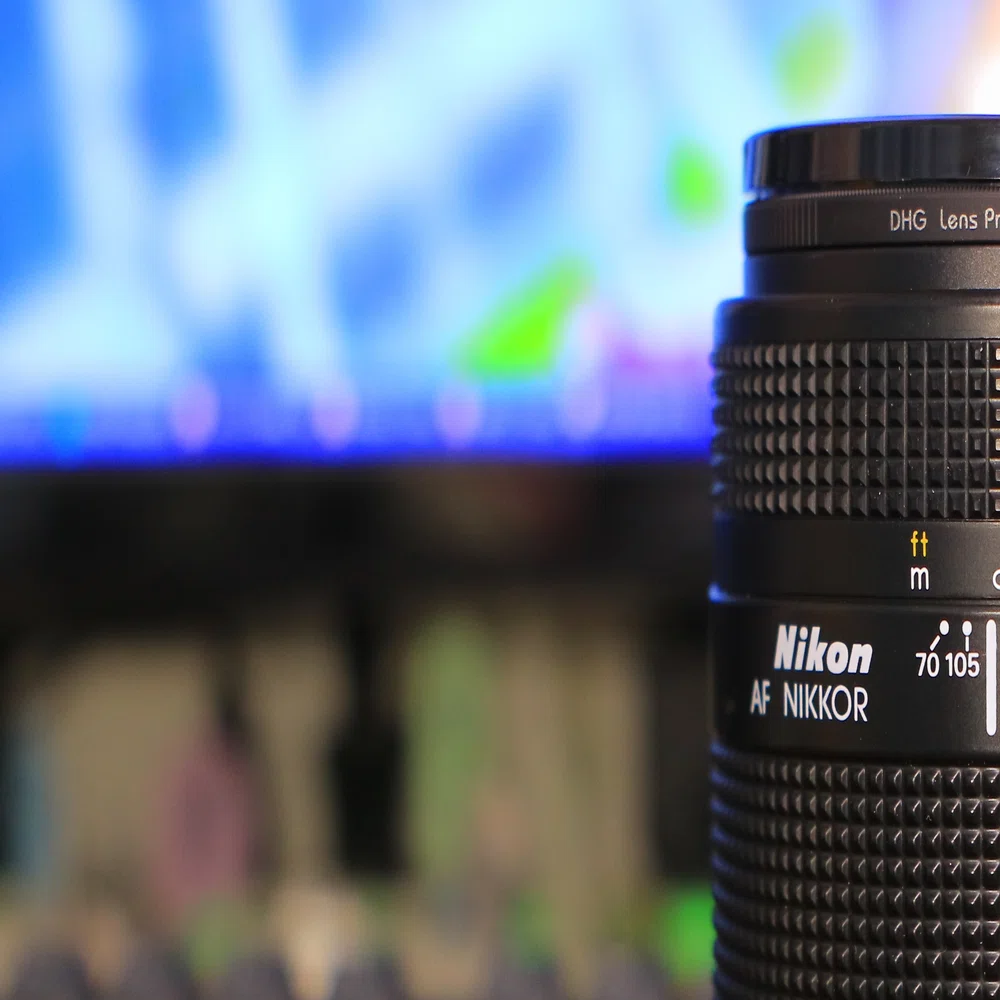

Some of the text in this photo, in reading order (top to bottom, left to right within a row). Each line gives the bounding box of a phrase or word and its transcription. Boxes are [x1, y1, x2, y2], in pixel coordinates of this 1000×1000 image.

[890, 208, 927, 231] DHG
[940, 208, 978, 231] Lens
[910, 530, 929, 558] ft
[910, 566, 930, 591] m
[773, 624, 873, 675] Nikon
[915, 651, 981, 678] 70 105
[750, 679, 869, 722] AF NIKKOR
